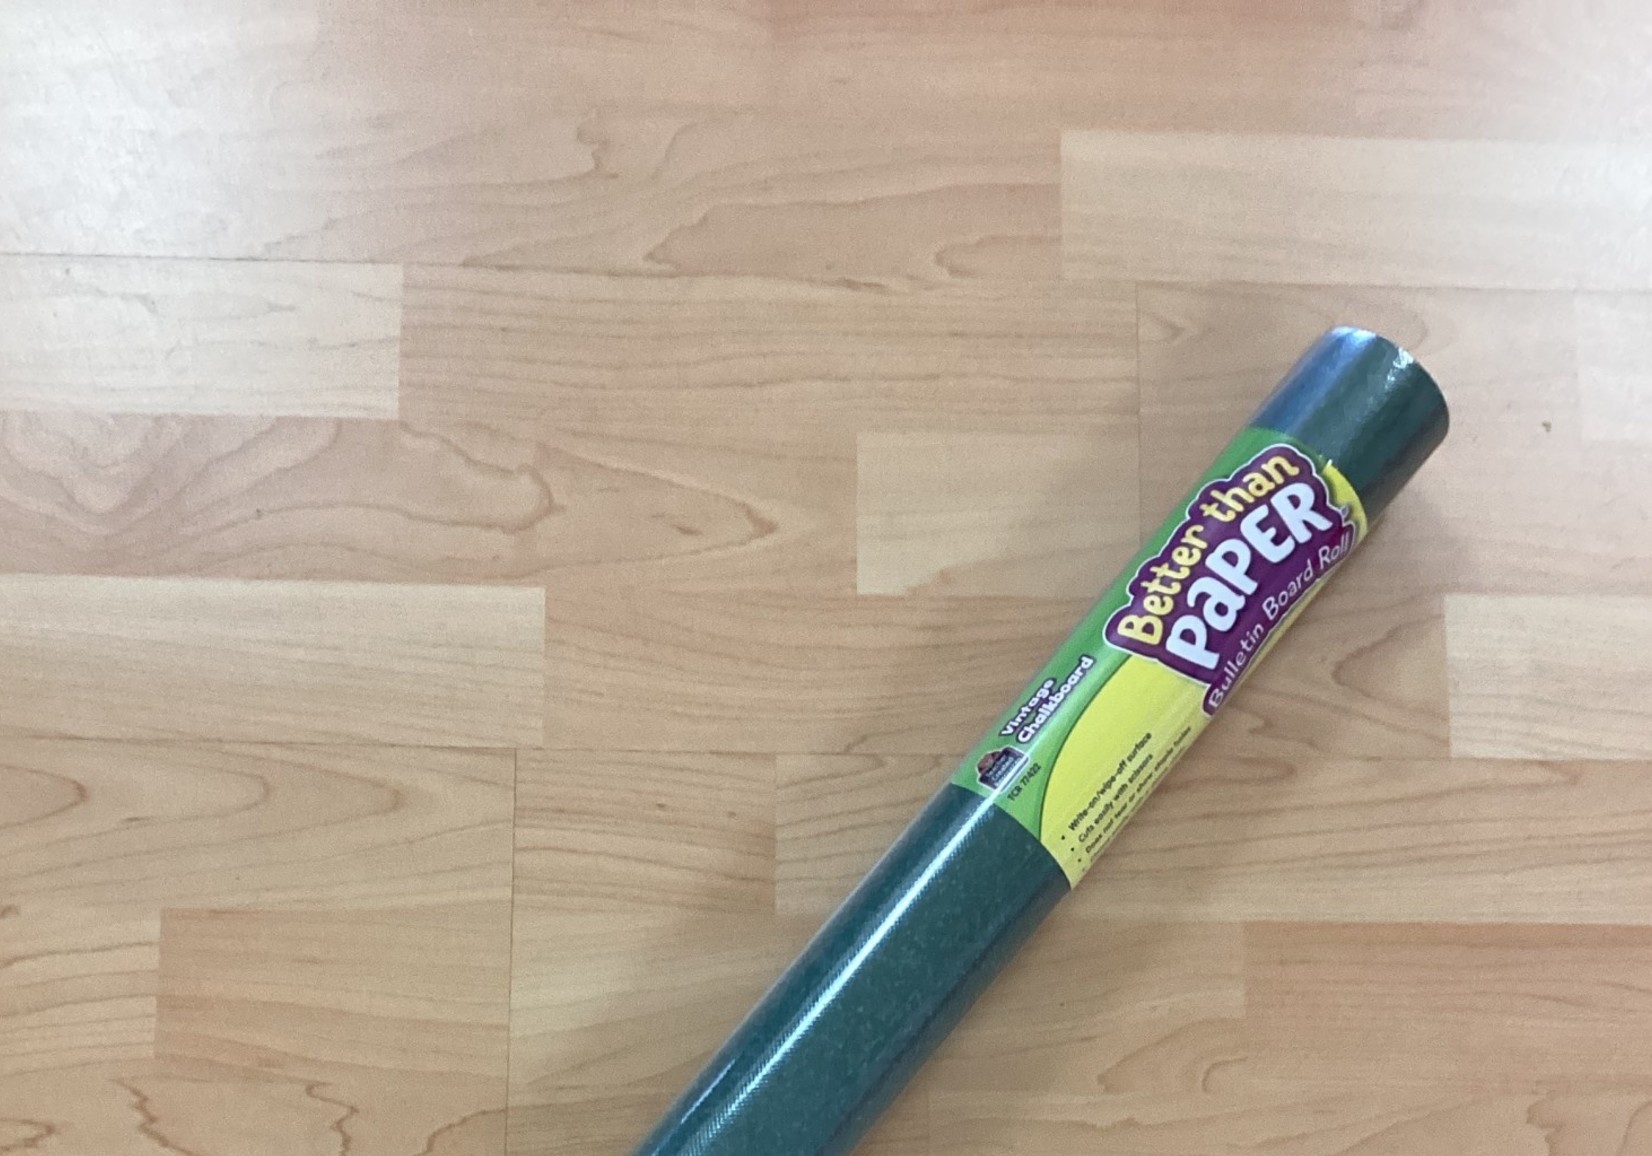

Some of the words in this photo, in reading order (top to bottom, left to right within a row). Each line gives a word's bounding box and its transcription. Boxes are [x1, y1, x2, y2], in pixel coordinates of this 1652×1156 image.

[1117, 524, 1207, 645] Better
[1200, 455, 1300, 522] than
[1208, 623, 1265, 708] Bulletin
[1262, 559, 1315, 620] Board
[1318, 530, 1352, 570] Roll
[1001, 679, 1055, 736] Vintage
[1018, 656, 1094, 743] Chalkboard
[1007, 785, 1023, 801] TCR
[1068, 759, 1128, 831] Write-on/wipe-off
[1127, 732, 1152, 762] surface
[1079, 824, 1095, 843] Cuts
[1094, 801, 1114, 825] easily
[1114, 783, 1129, 801] with
[1128, 754, 1153, 784] scissors
